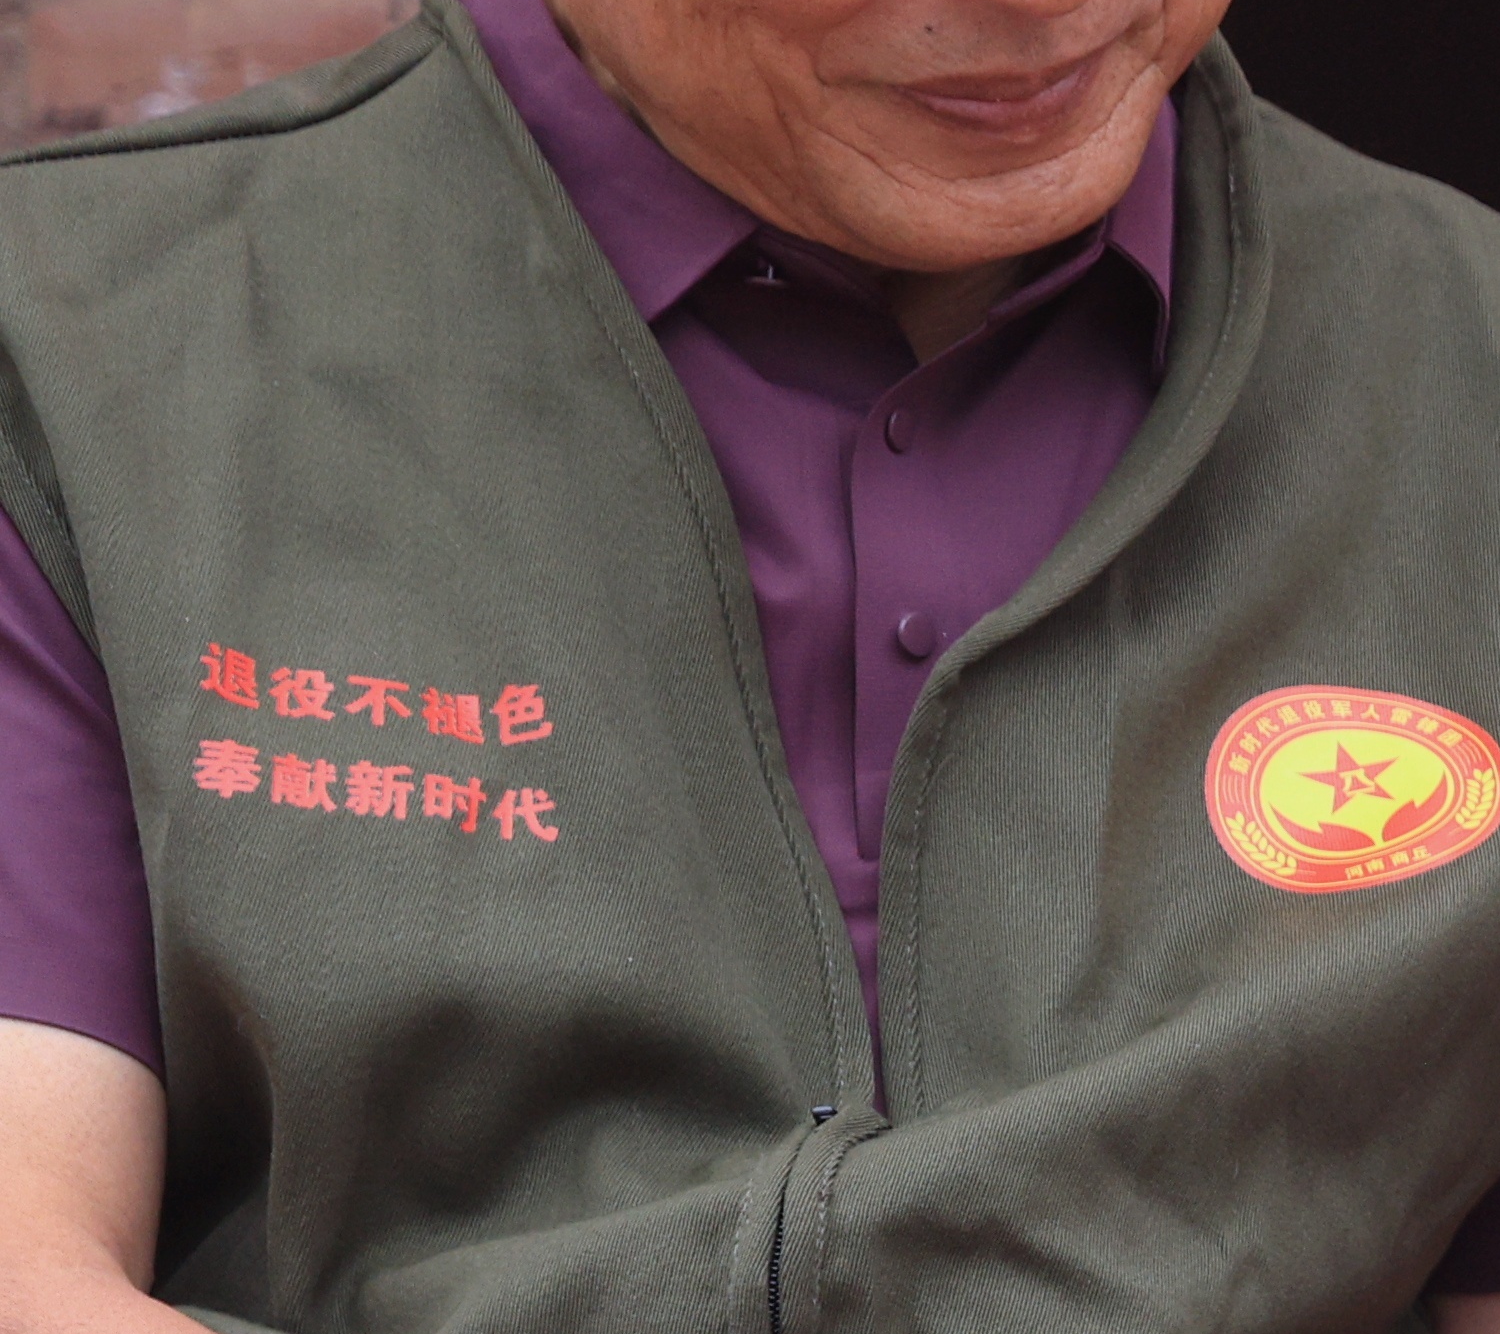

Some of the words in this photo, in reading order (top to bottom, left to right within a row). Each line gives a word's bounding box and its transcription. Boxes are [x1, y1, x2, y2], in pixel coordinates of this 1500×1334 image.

[200, 642, 554, 747] 退役不褪色
[1228, 699, 1463, 776] 新时代退役军人雷锋团
[194, 738, 559, 842] 奉献新时代
[1344, 857, 1386, 880] 河南
[1391, 845, 1432, 868] 商丘
